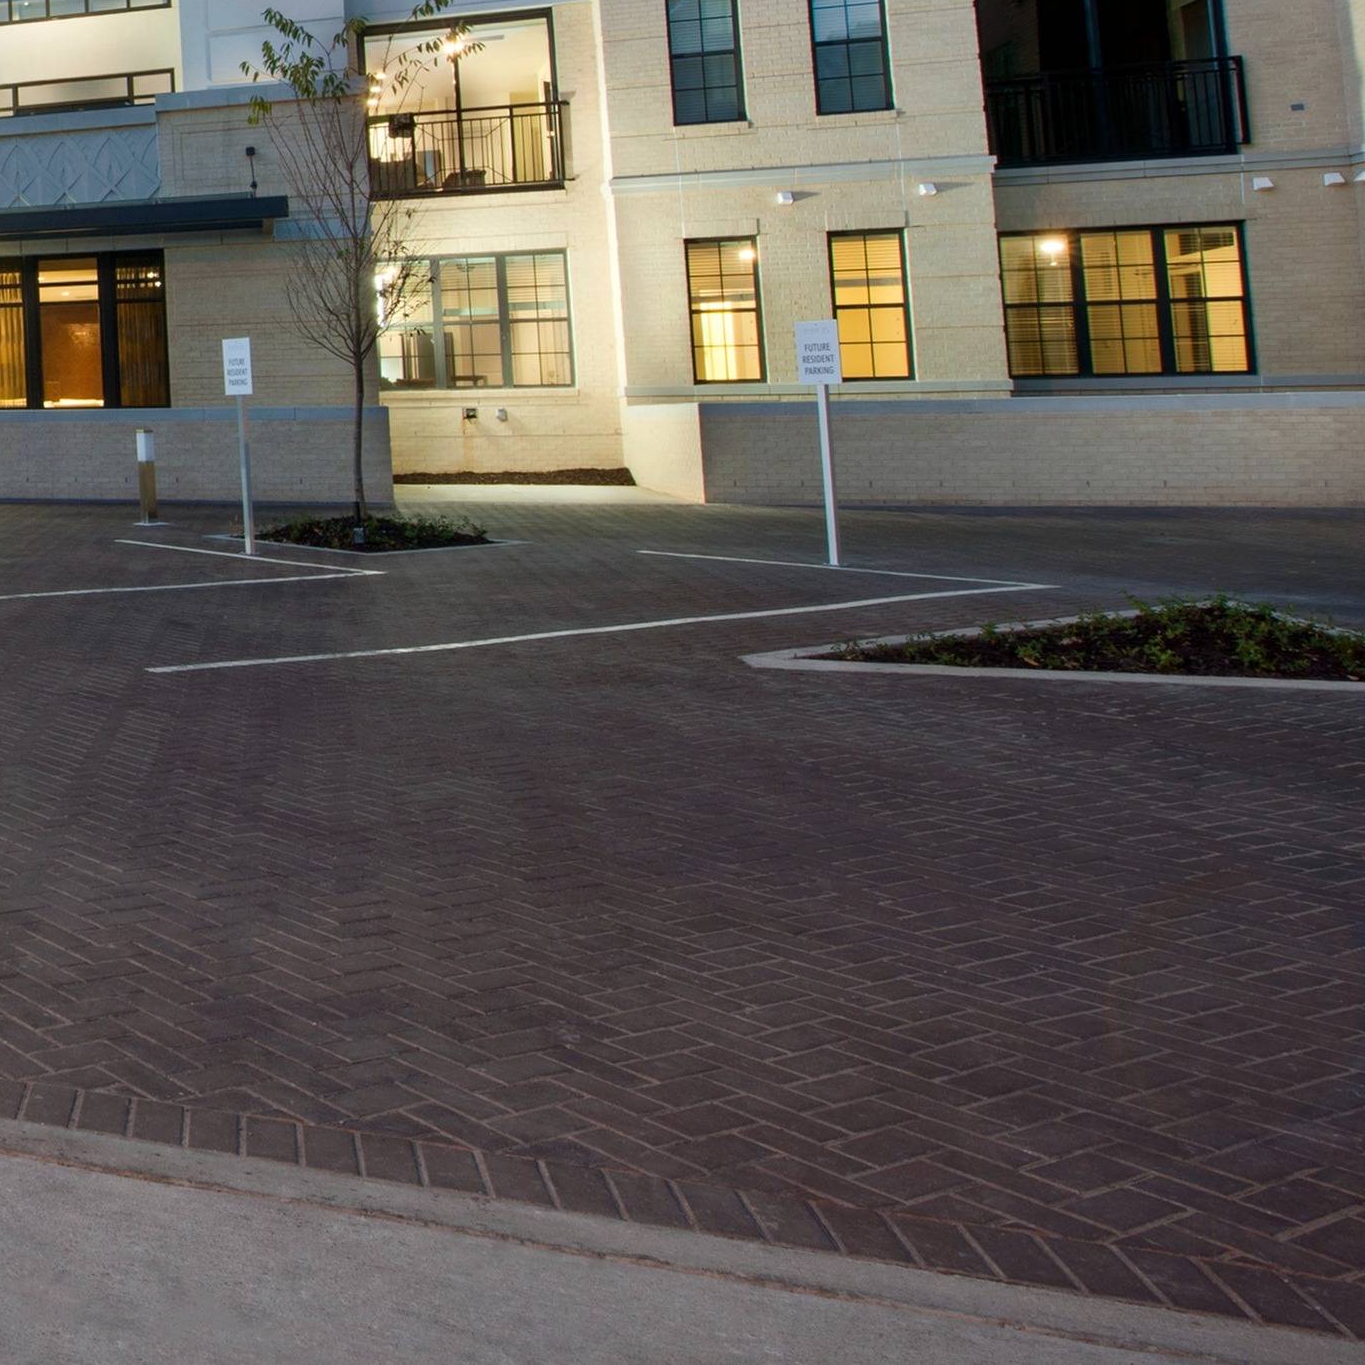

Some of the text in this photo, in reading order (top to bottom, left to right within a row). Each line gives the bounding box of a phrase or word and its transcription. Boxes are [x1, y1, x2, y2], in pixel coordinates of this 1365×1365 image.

[804, 342, 831, 352] FUTURE
[802, 354, 834, 364] RESIDENT
[804, 366, 835, 375] PARKING
